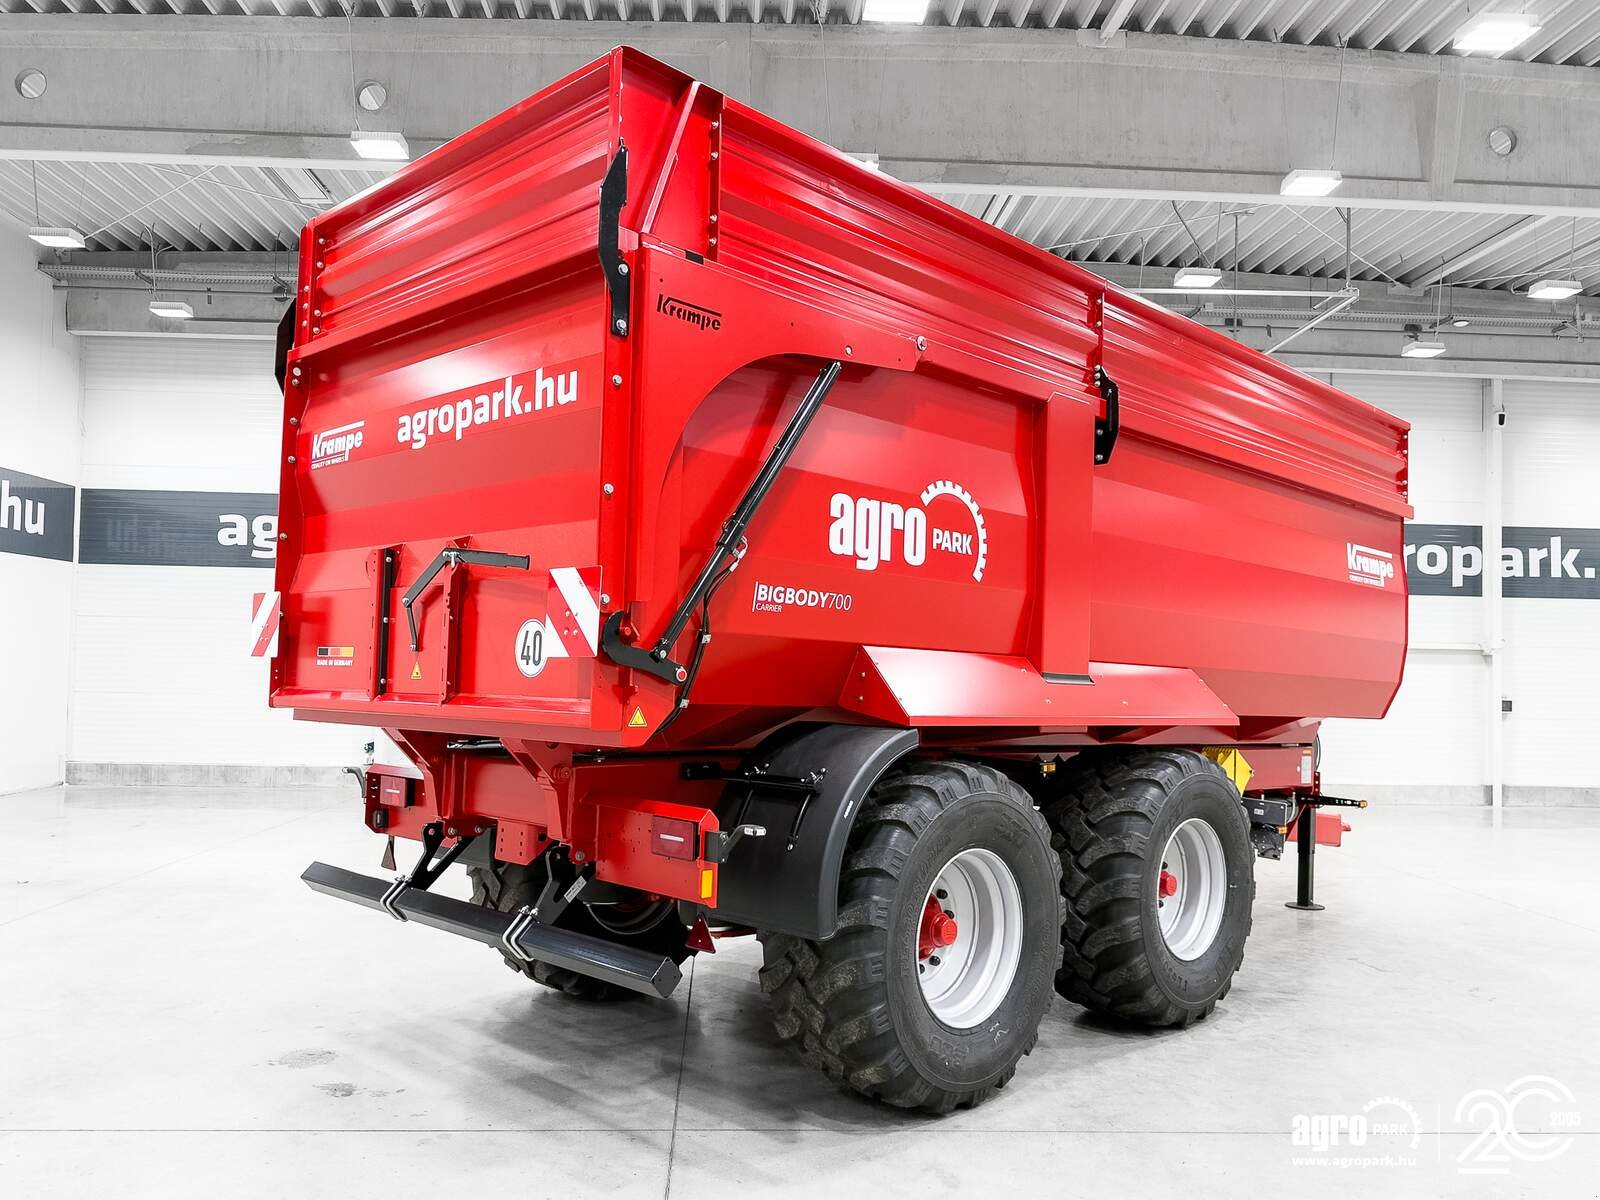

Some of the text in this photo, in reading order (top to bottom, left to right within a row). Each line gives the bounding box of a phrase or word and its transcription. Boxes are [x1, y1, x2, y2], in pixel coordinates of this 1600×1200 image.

[656, 293, 722, 331] Krampe
[397, 367, 578, 450] agropark.hu
[311, 420, 365, 462] Krampe
[828, 492, 973, 571] agro PARK
[1346, 542, 1394, 587] Krampe
[755, 602, 782, 612] CARRIER
[520, 630, 542, 666] 40
